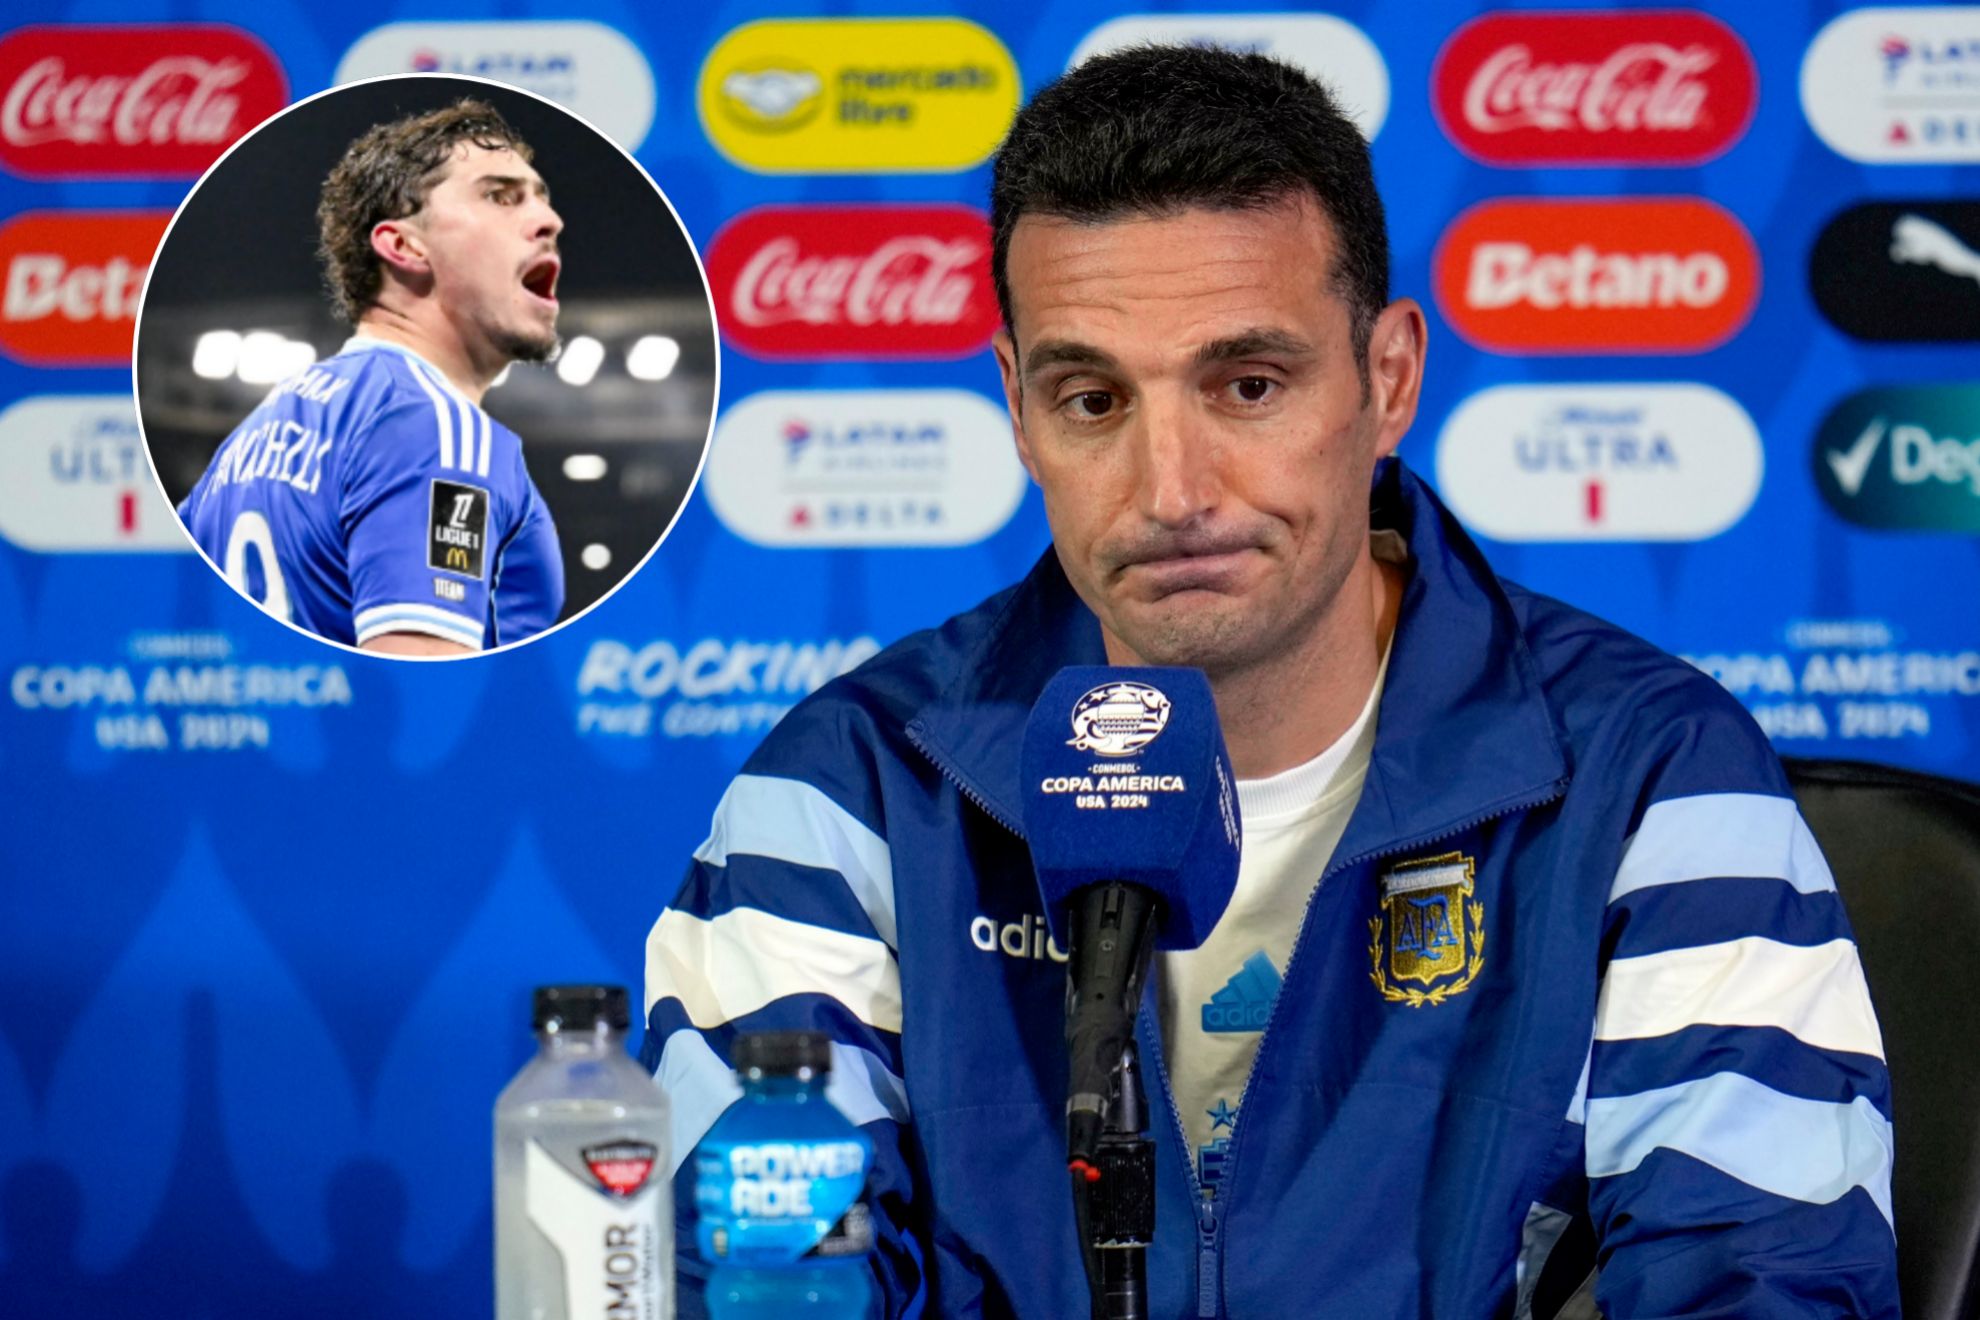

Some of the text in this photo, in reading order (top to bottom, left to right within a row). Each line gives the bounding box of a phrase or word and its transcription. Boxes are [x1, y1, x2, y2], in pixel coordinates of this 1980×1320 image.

[1467, 241, 1729, 310] Betano
[49, 445, 155, 484] ULT
[1513, 434, 1679, 473] ULTRA
[436, 524, 472, 549] LIGUE
[11, 664, 353, 706] COPA AMERICA
[95, 713, 169, 748] USA
[1041, 776, 1185, 793] COPA AMERICA
[1092, 763, 1137, 775] CONMEBOL
[1076, 795, 1149, 809] USA 2024
[729, 1143, 866, 1180] POWER
